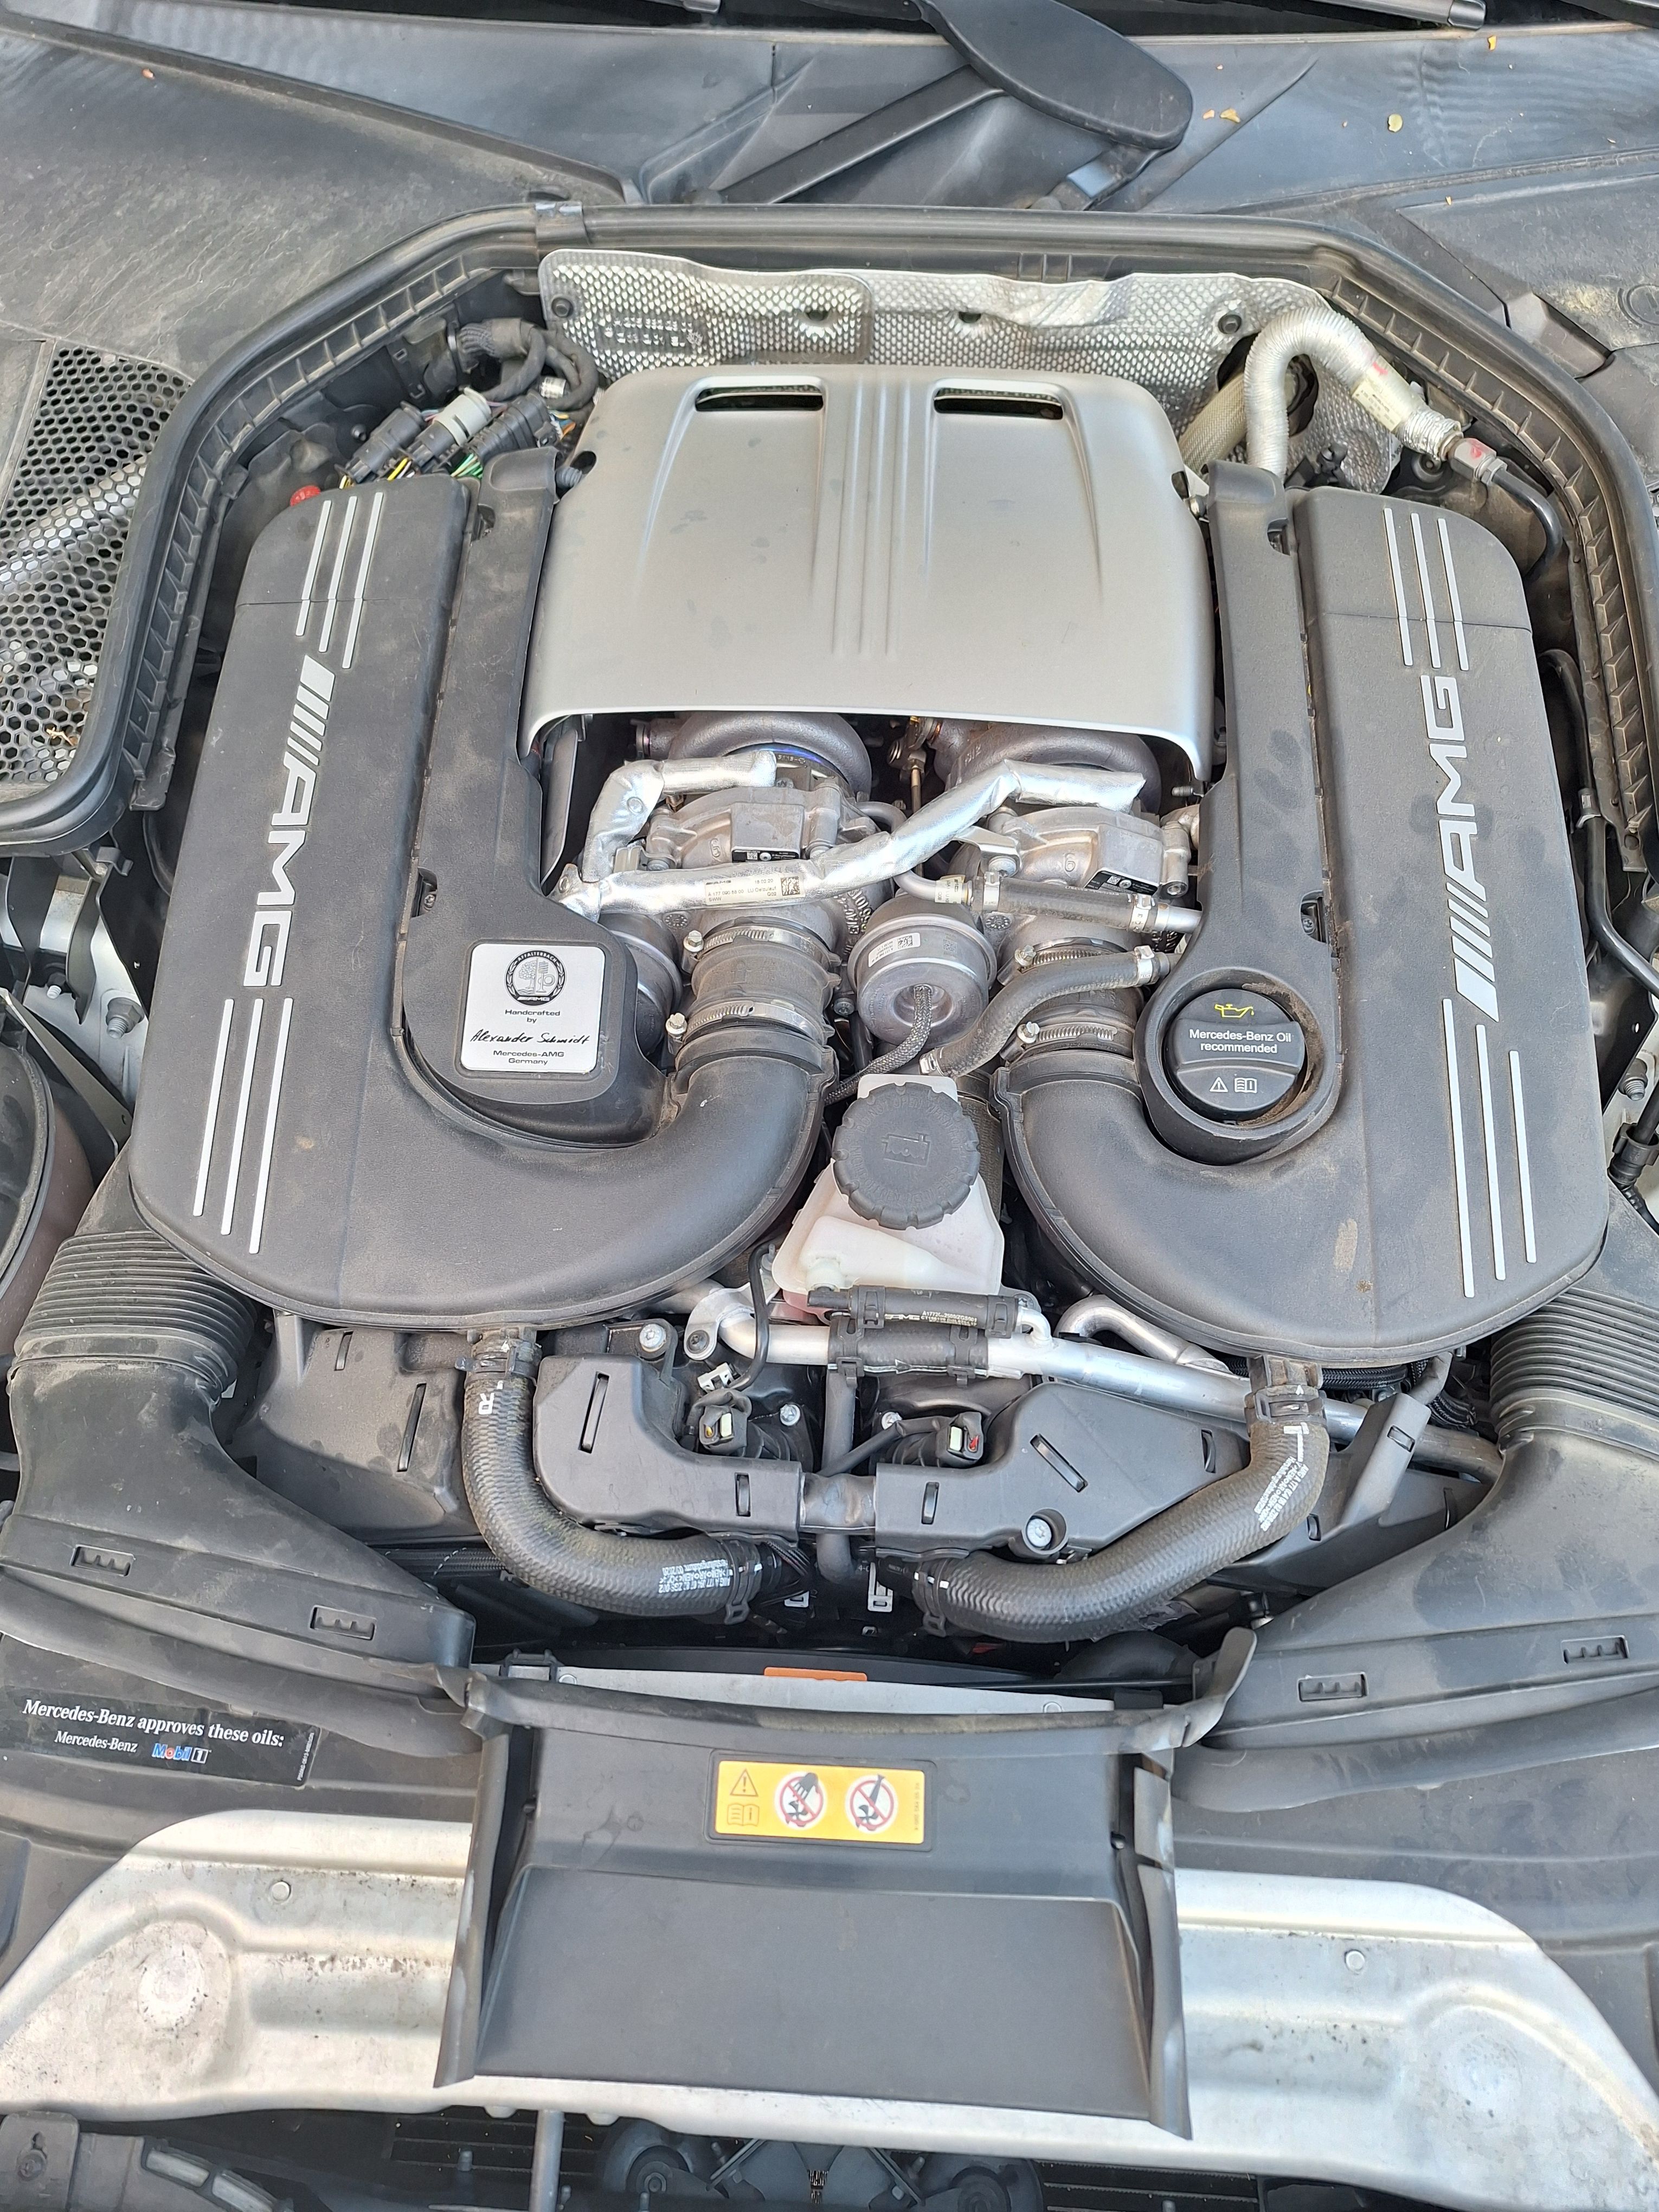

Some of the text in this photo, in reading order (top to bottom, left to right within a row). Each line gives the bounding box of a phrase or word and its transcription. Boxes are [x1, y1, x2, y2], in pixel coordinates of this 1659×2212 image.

[1420, 675, 1486, 902] AMG
[243, 751, 316, 987] AMG
[470, 1028, 590, 1045] Alexander Schmidt
[1189, 1028, 1291, 1043] Mercedes-Benz Oil
[1200, 1041, 1277, 1053] recommended
[22, 1699, 285, 1747] Mercedes-Benz approves these oils:
[54, 1730, 138, 1753] Mercedes-Benz
[152, 1742, 190, 1761] Mobil
